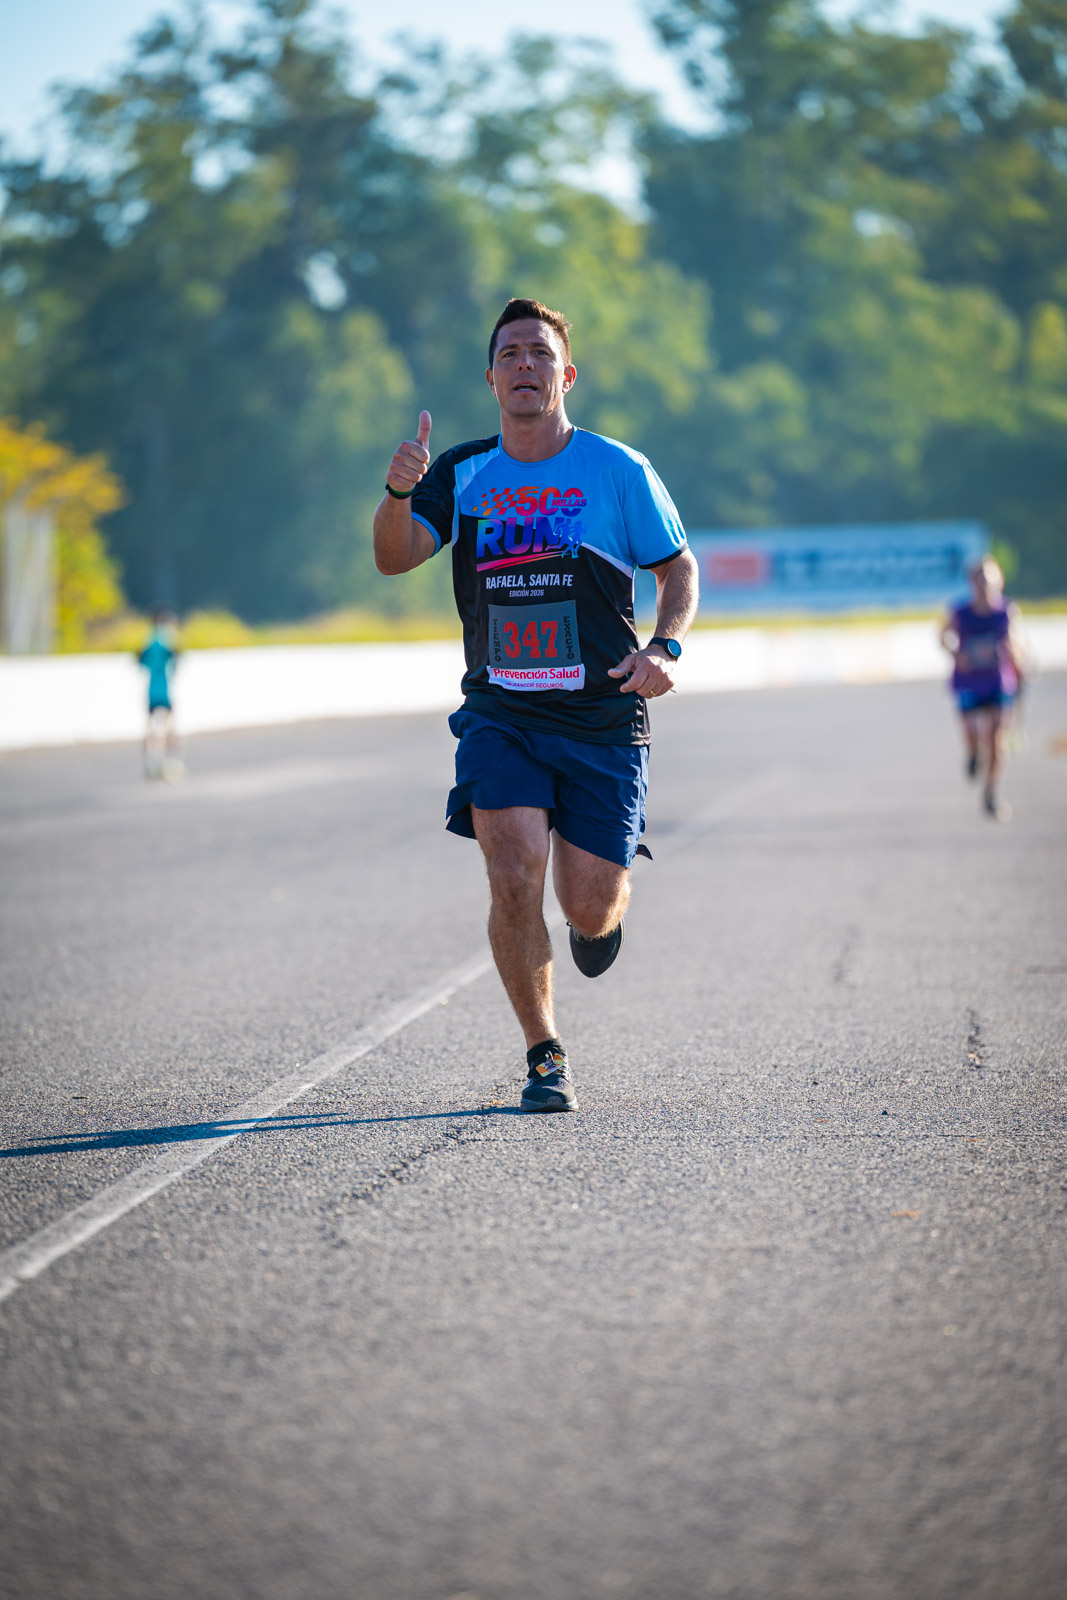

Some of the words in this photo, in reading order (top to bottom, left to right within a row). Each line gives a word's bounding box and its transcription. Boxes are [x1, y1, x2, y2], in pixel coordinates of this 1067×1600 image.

[515, 486, 584, 517] 500
[552, 498, 587, 507] MILLAS
[486, 575, 526, 590] RAFAELA,
[529, 574, 560, 587] SANTA
[562, 574, 574, 587] FE
[509, 589, 530, 598] EDICIÓN
[493, 618, 502, 662] TIEMPO
[503, 621, 558, 658] 347
[563, 616, 575, 660] EXACTO
[493, 668, 548, 680] Prevención
[549, 666, 580, 679] Salud
